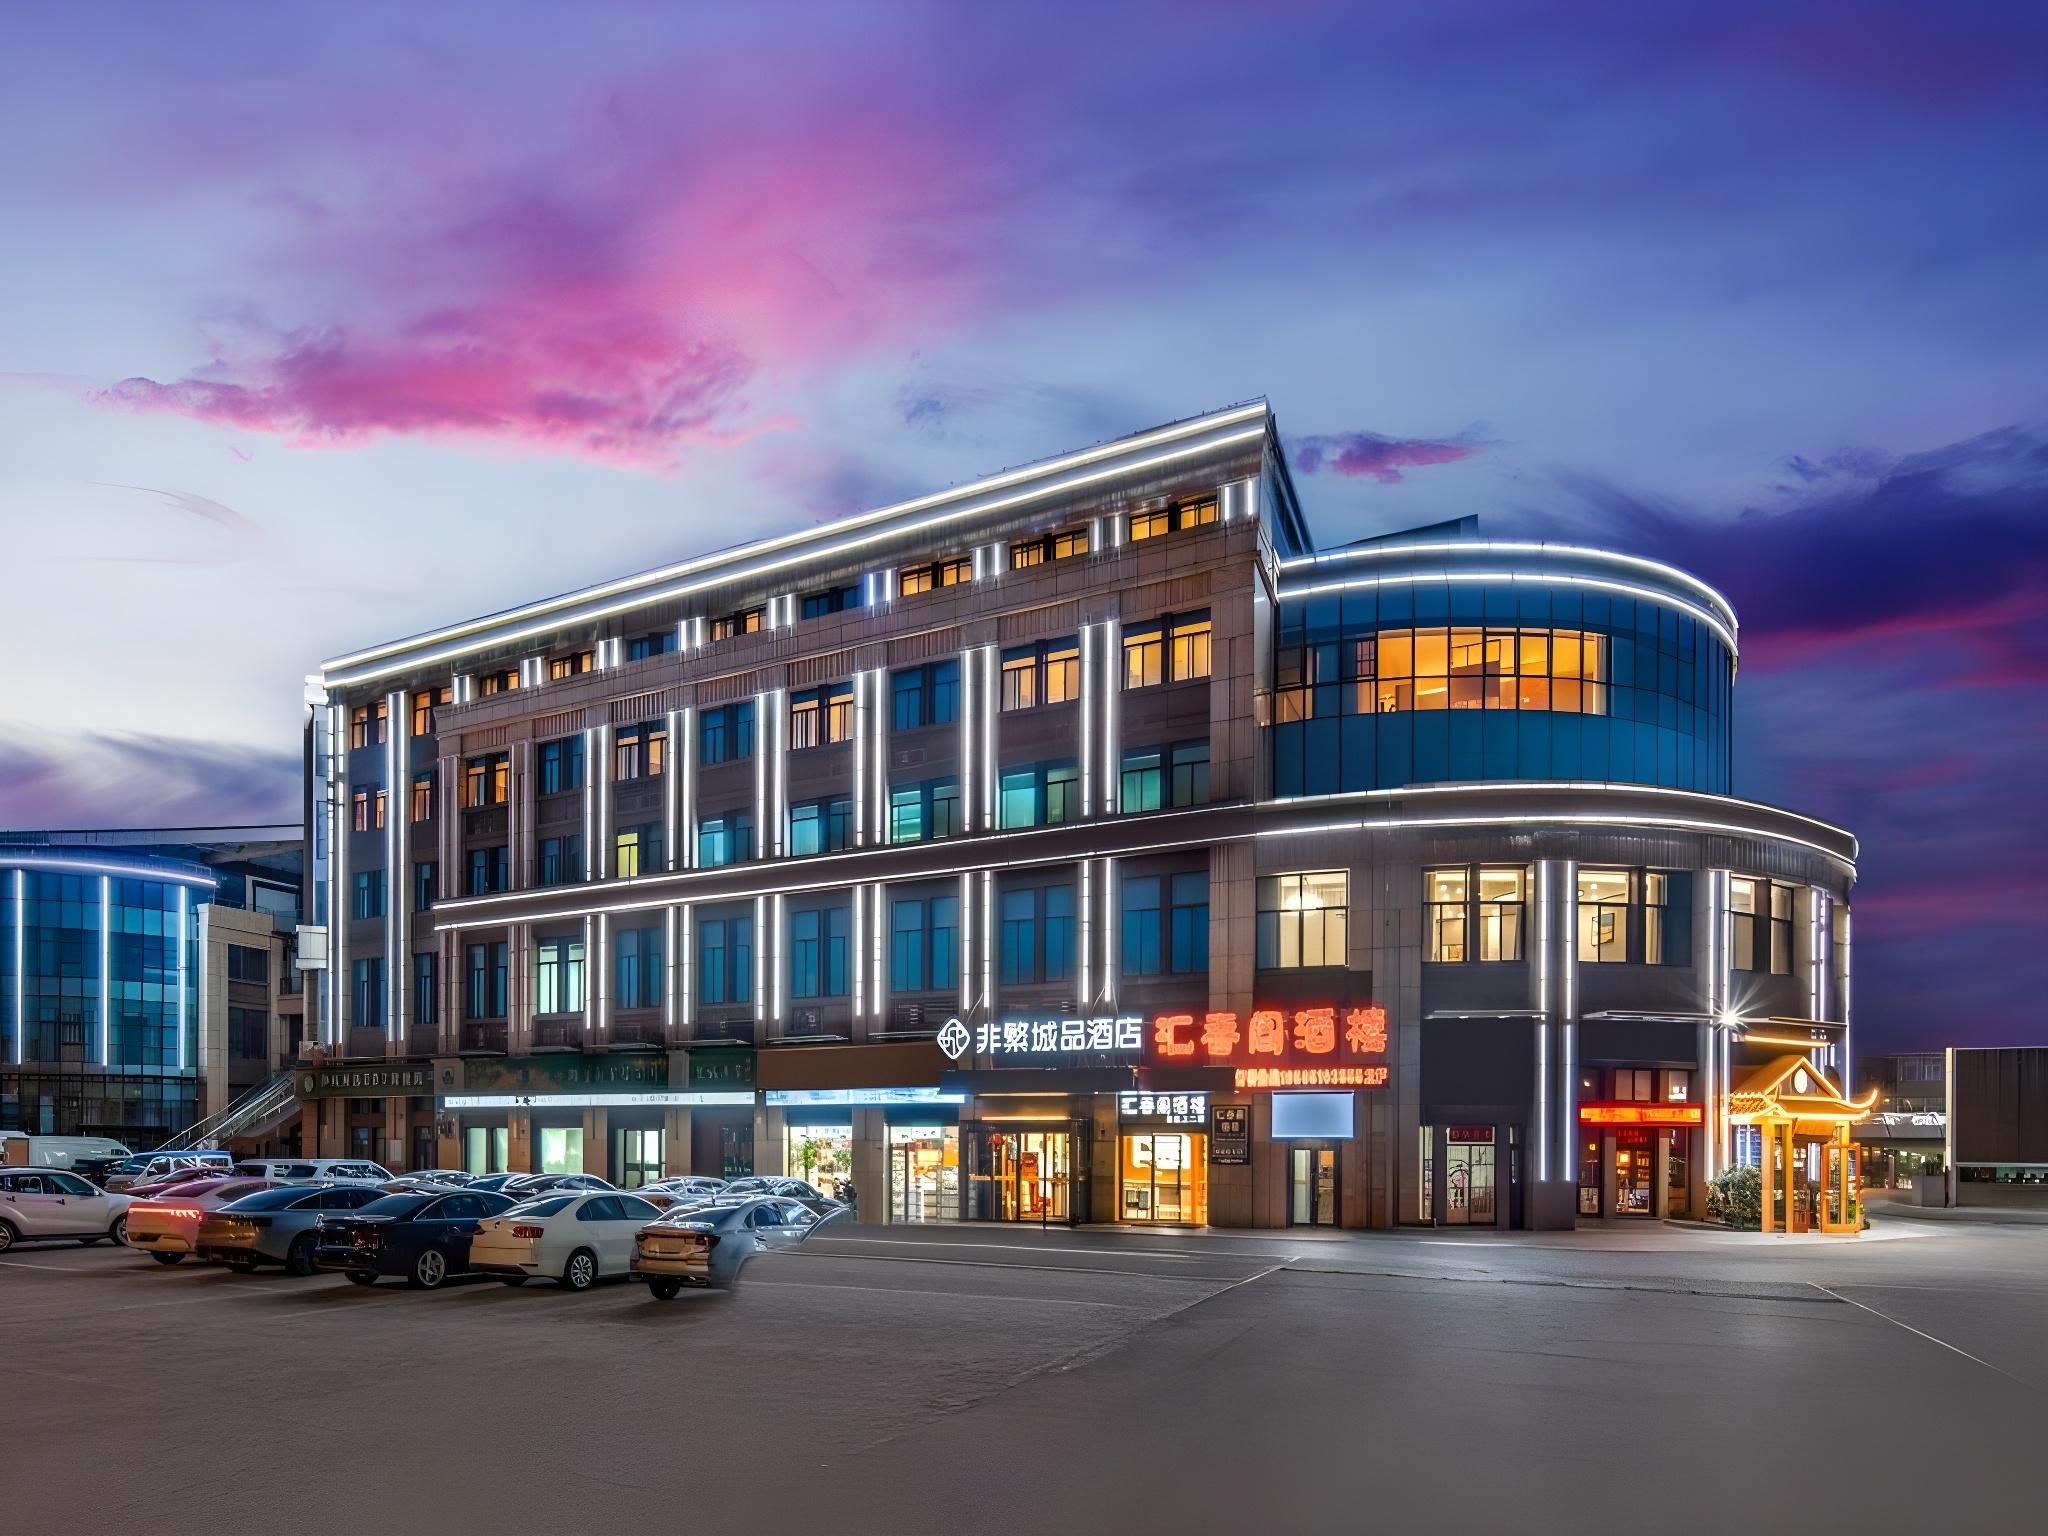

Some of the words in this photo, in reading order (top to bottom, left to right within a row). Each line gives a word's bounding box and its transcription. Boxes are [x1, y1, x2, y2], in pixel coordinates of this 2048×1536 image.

[976, 1017, 1143, 1054] 非繁城品酒店
